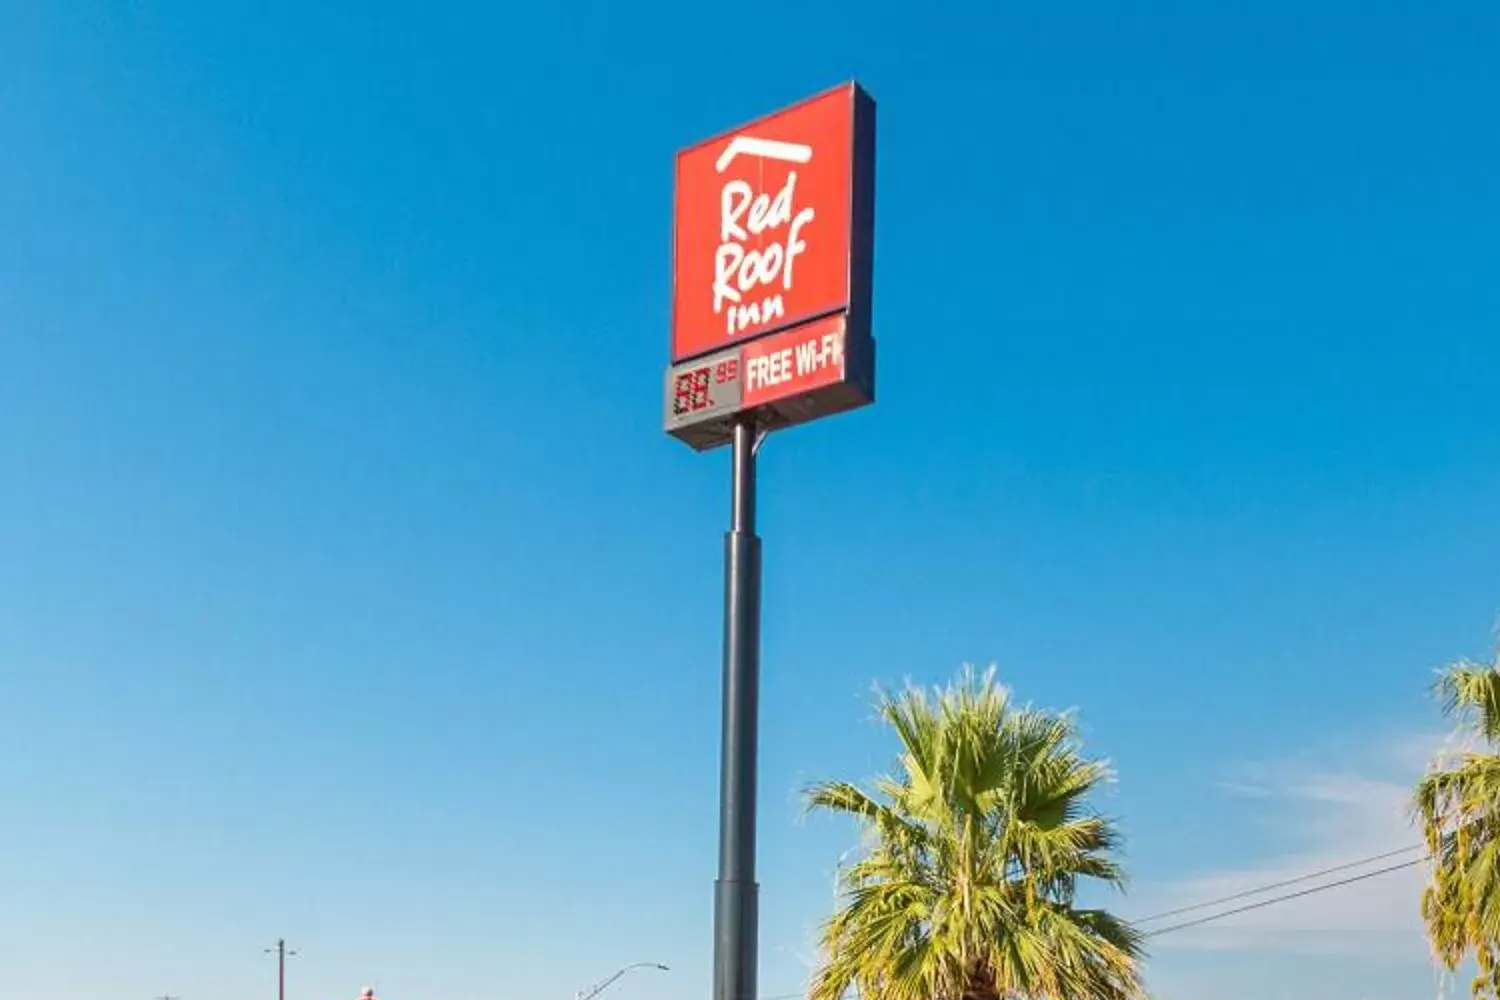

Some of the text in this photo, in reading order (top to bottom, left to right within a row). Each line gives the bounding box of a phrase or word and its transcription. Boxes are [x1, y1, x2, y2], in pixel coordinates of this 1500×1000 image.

[720, 171, 797, 243] Red
[713, 207, 815, 314] Roof
[746, 347, 793, 392] FREE
